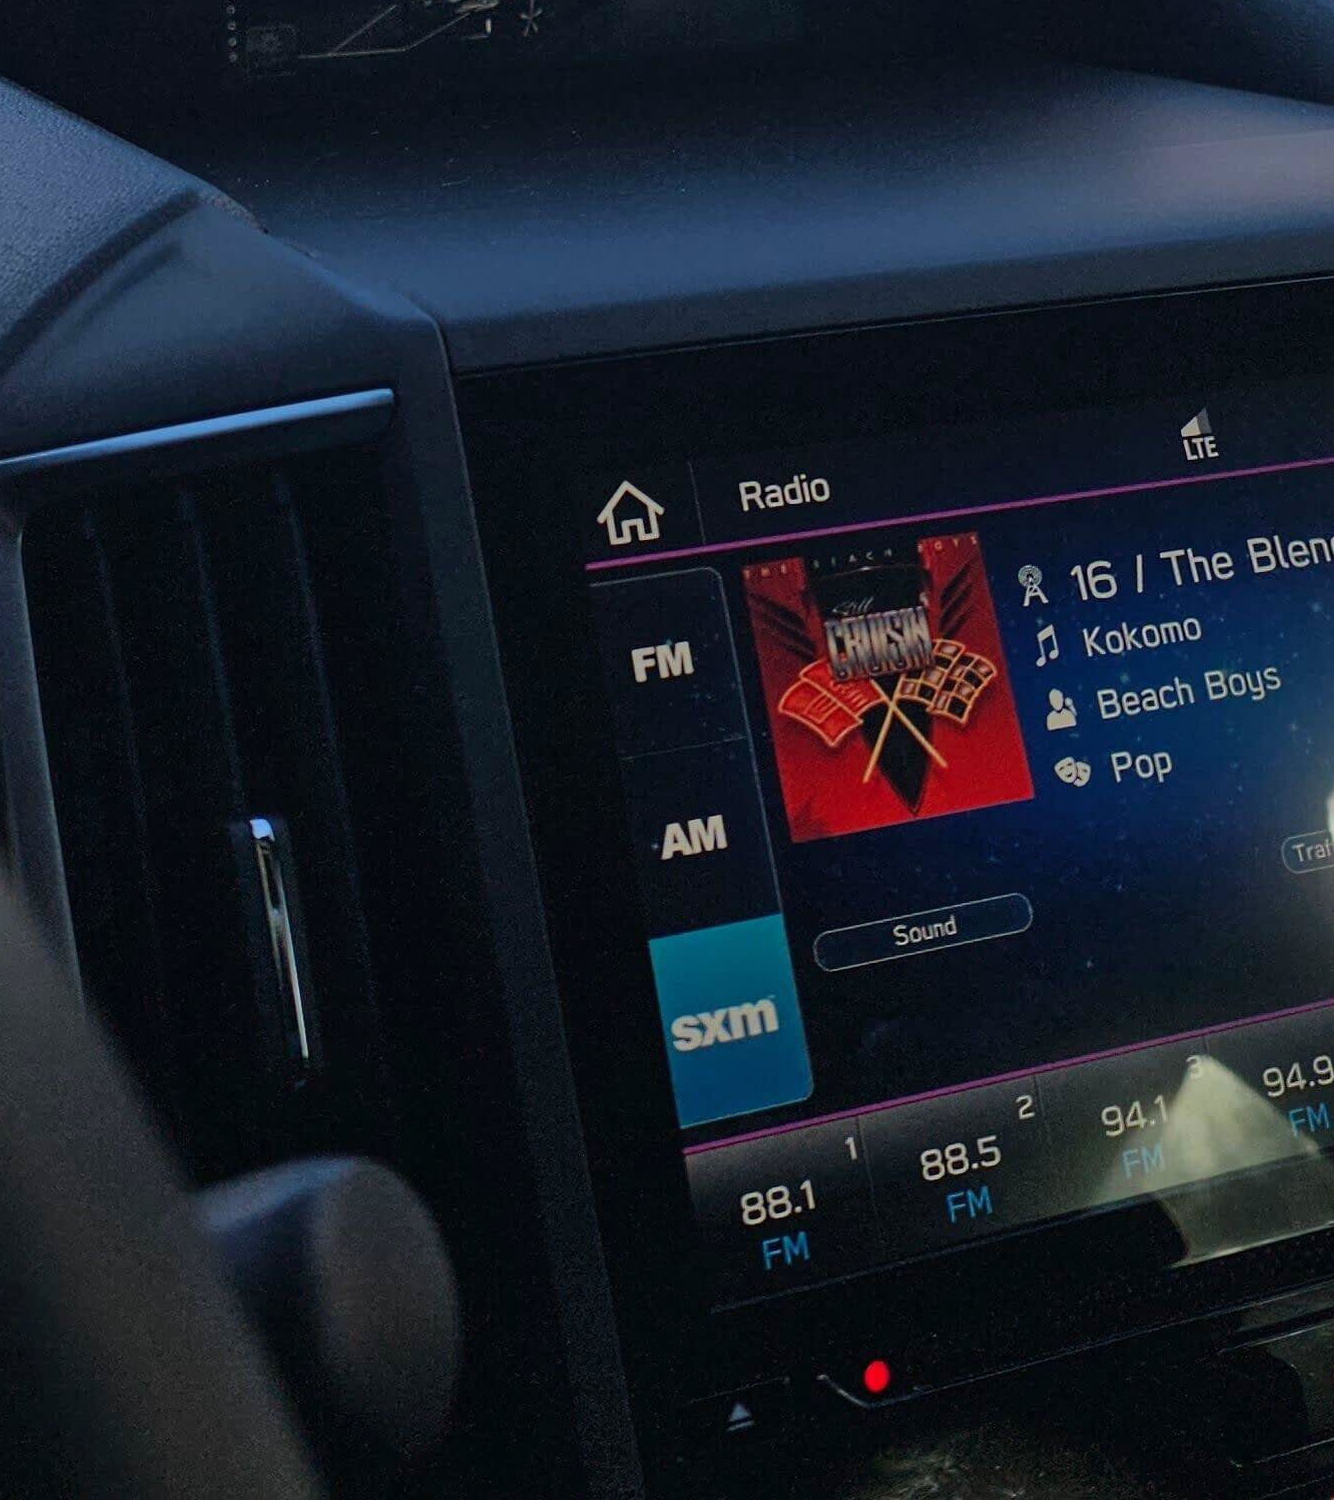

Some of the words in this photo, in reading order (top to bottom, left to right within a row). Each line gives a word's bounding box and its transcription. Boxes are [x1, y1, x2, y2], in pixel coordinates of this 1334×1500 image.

[1182, 436, 1219, 461] LTE
[739, 473, 830, 511] Radio
[1071, 560, 1119, 601] 16
[1160, 547, 1235, 587] The
[1083, 616, 1202, 657] Kokomo
[631, 641, 695, 683] FM
[1097, 677, 1195, 720] Beach
[1204, 666, 1281, 703] Boys
[1111, 750, 1173, 783] Pop
[662, 814, 727, 860] AM
[893, 915, 957, 947] Sound
[671, 998, 779, 1052] sxm
[1015, 1095, 1035, 1120] 2
[1101, 1094, 1167, 1137] 94.1
[1289, 1102, 1331, 1137] FM
[844, 1137, 858, 1160] 1
[920, 1136, 1002, 1182] 88.5
[1122, 1144, 1164, 1179] FM
[740, 1180, 816, 1226] 88.1
[946, 1186, 993, 1224] FM
[762, 1231, 810, 1269] FM
